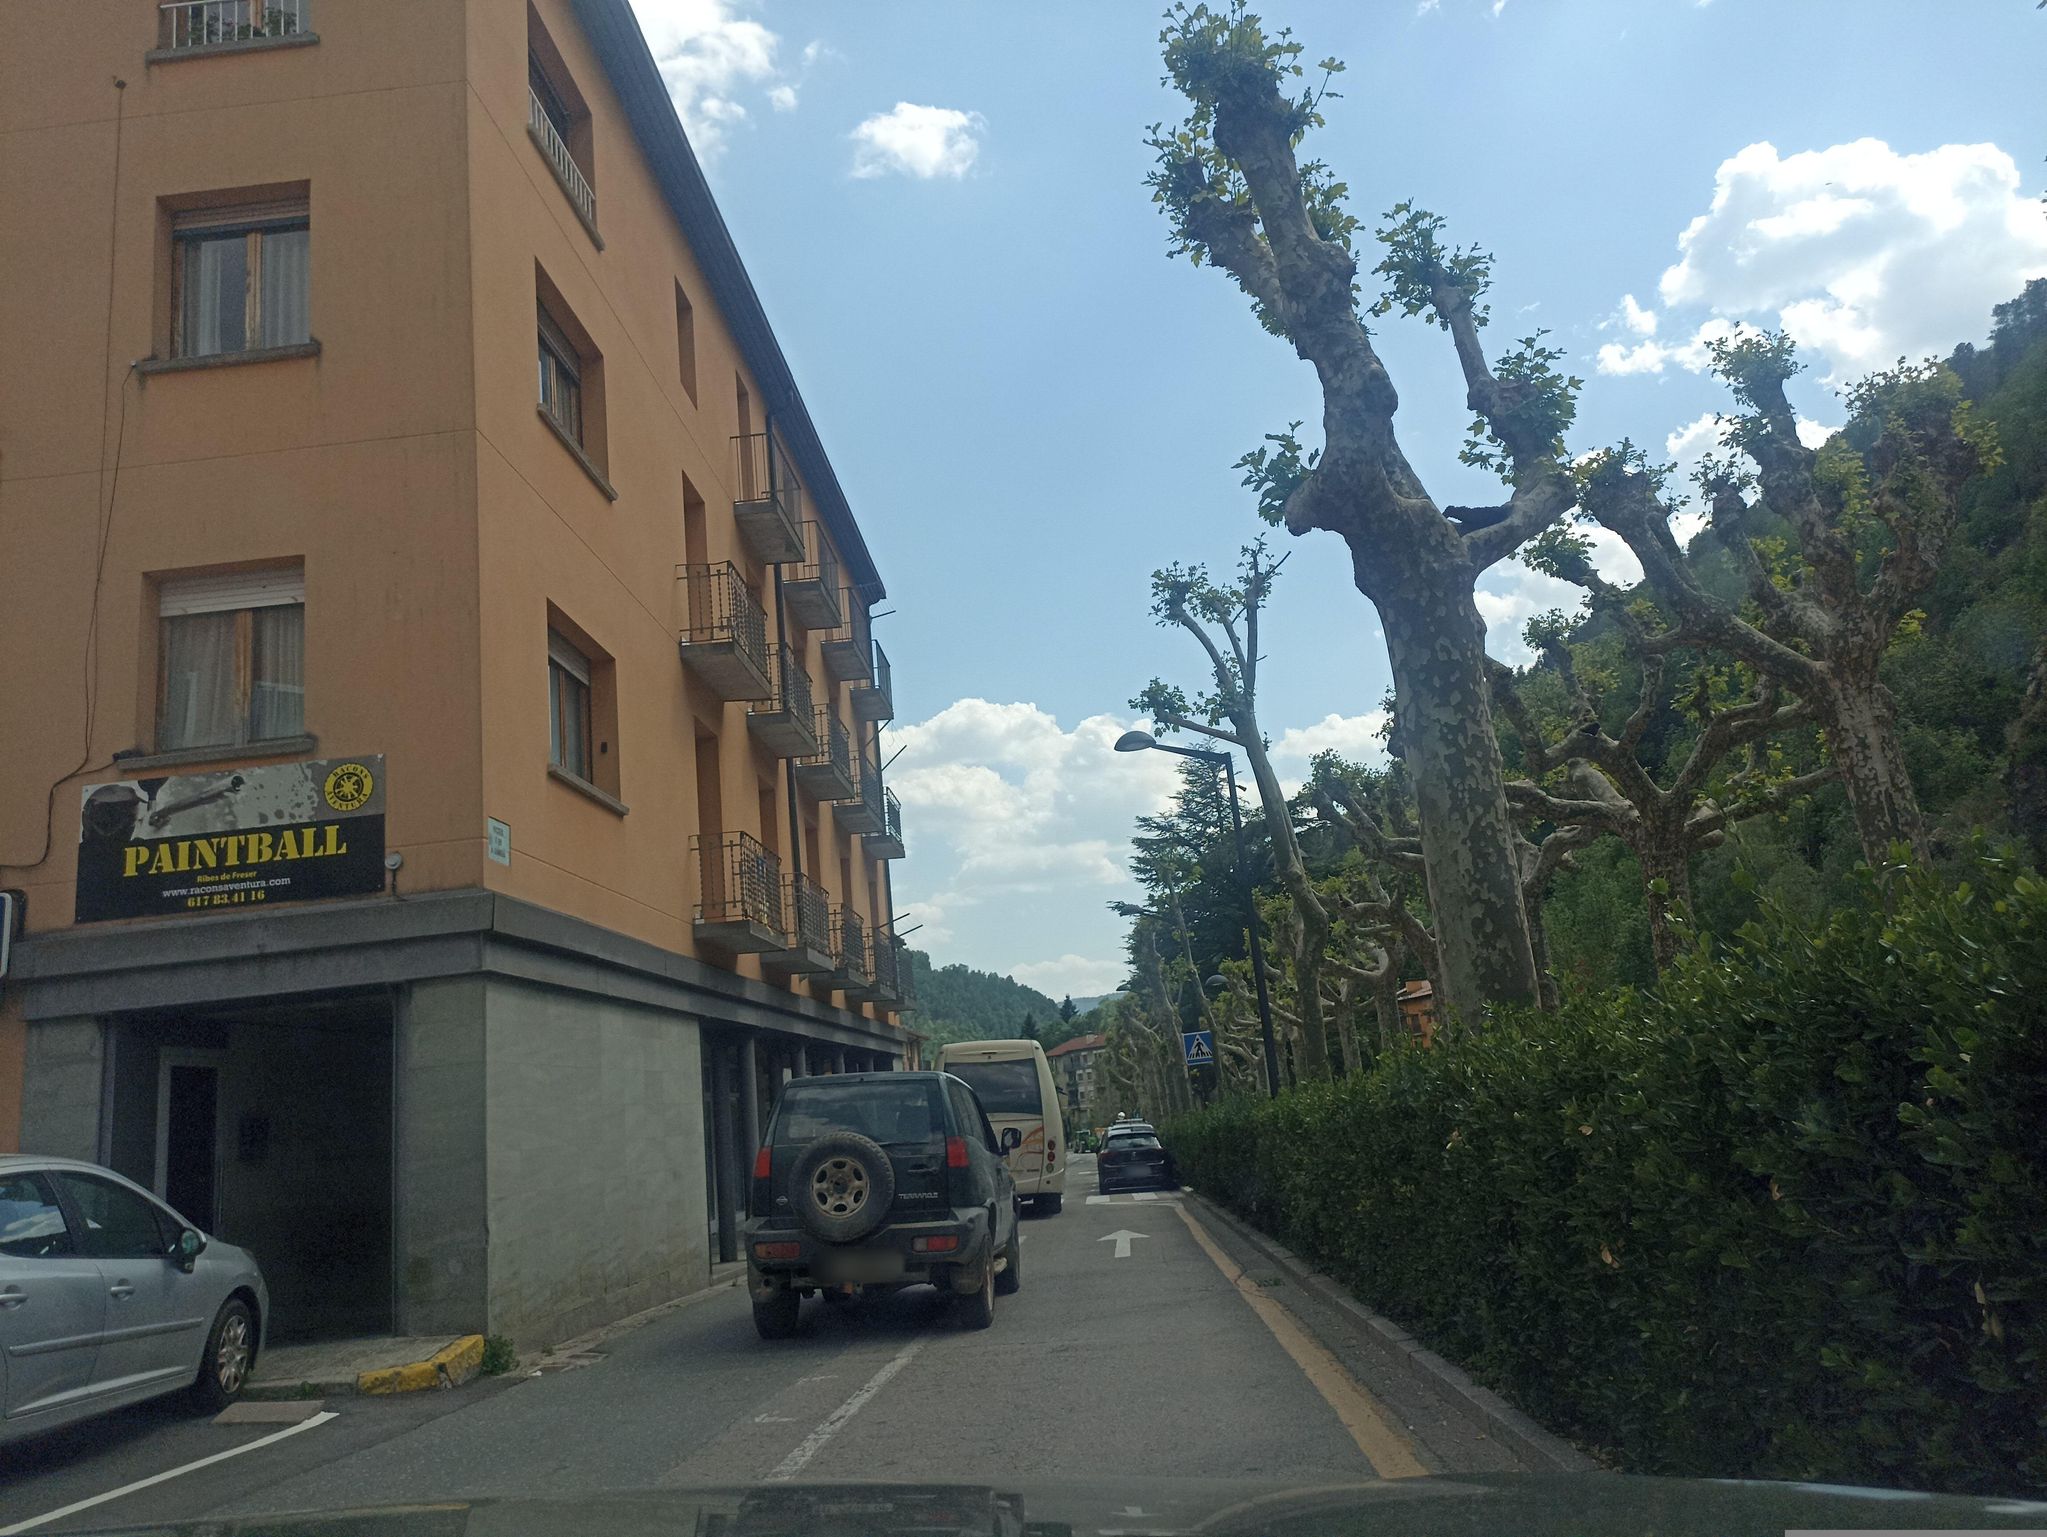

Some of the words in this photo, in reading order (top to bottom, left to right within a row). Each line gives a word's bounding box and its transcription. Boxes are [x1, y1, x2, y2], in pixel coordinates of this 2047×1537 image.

[326, 791, 369, 810] AVENTURA
[123, 825, 347, 877] PAINTBALL
[197, 875, 219, 883] Ribes
[220, 872, 231, 880] de
[232, 871, 257, 879] Freser
[162, 877, 291, 898] www.raconsaventura.com
[187, 896, 210, 908] 617
[251, 890, 265, 901] 16
